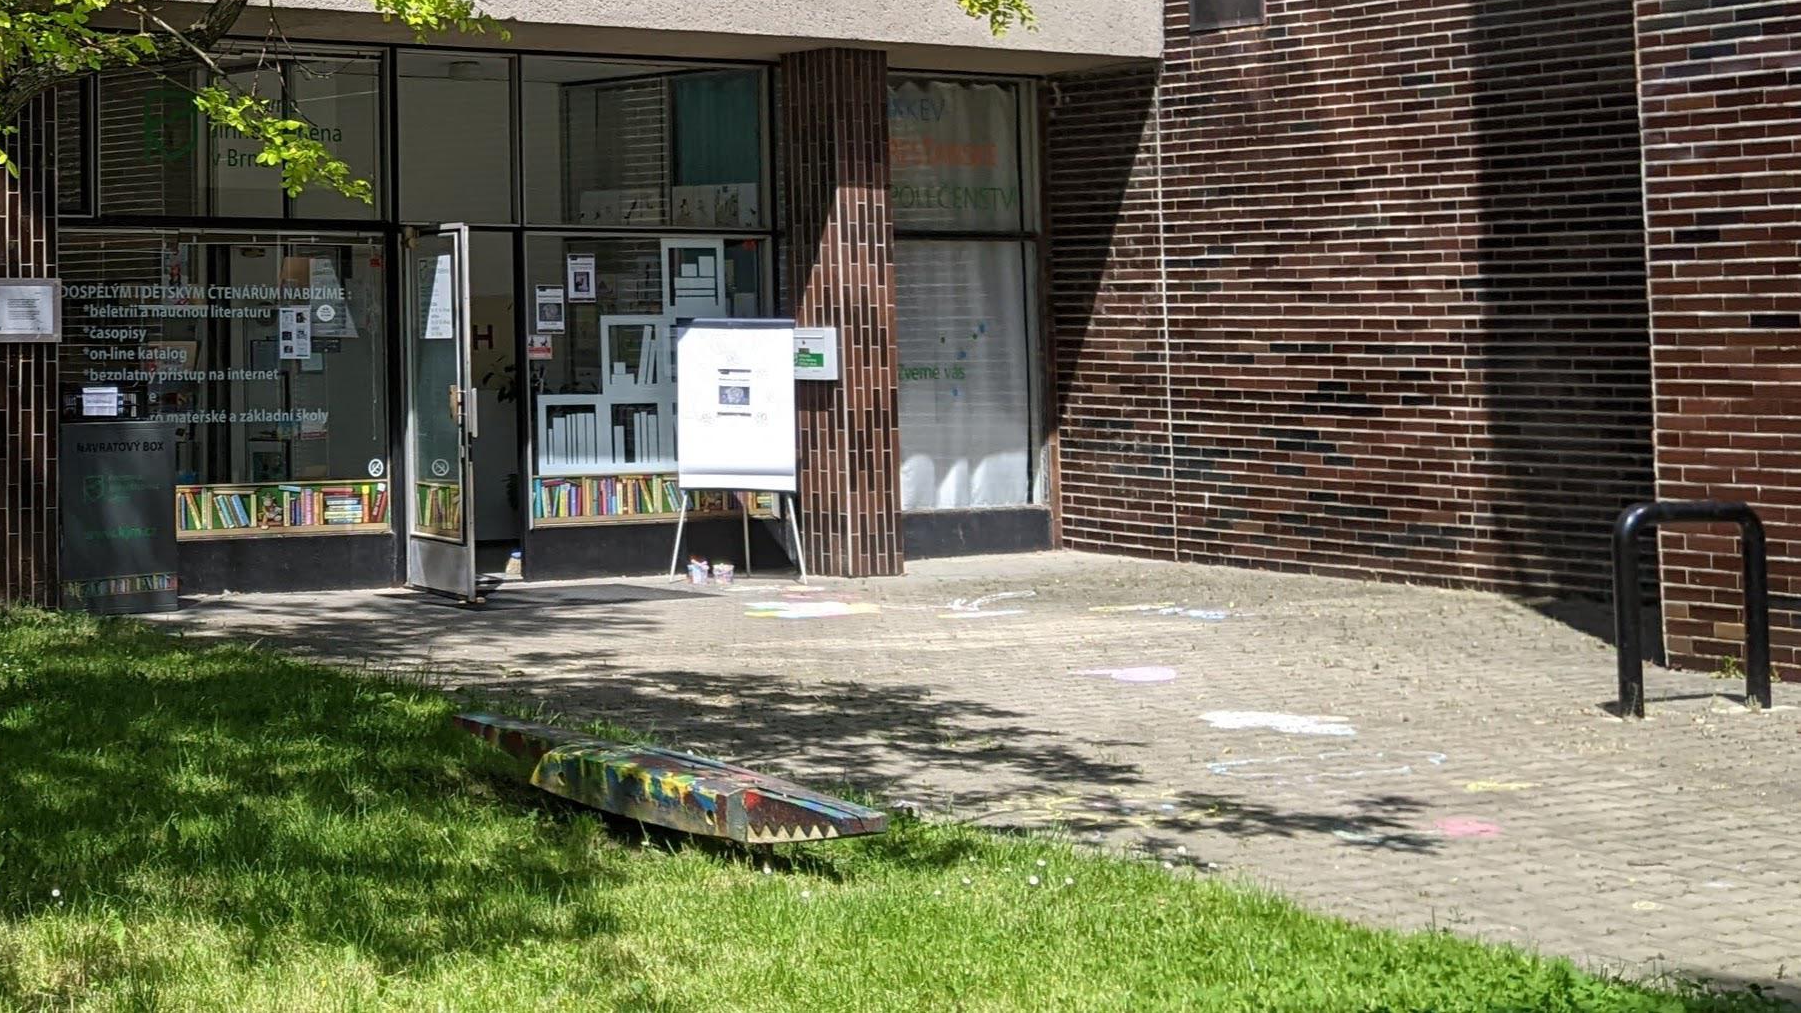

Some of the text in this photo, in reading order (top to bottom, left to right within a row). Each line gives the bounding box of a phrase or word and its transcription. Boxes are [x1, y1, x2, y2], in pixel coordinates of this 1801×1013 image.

[227, 148, 269, 167] Brn
[142, 283, 205, 299] DĚTSKÝM
[207, 283, 280, 300] ČTENÁŘŮM
[210, 304, 271, 318] literaturu
[137, 346, 188, 362] katalog
[158, 369, 206, 384] přístup
[209, 370, 225, 381] na
[227, 367, 279, 381] internet
[166, 408, 227, 424] mateřské
[240, 408, 294, 424] základní
[297, 408, 329, 425] školy
[142, 440, 165, 452] BOX
